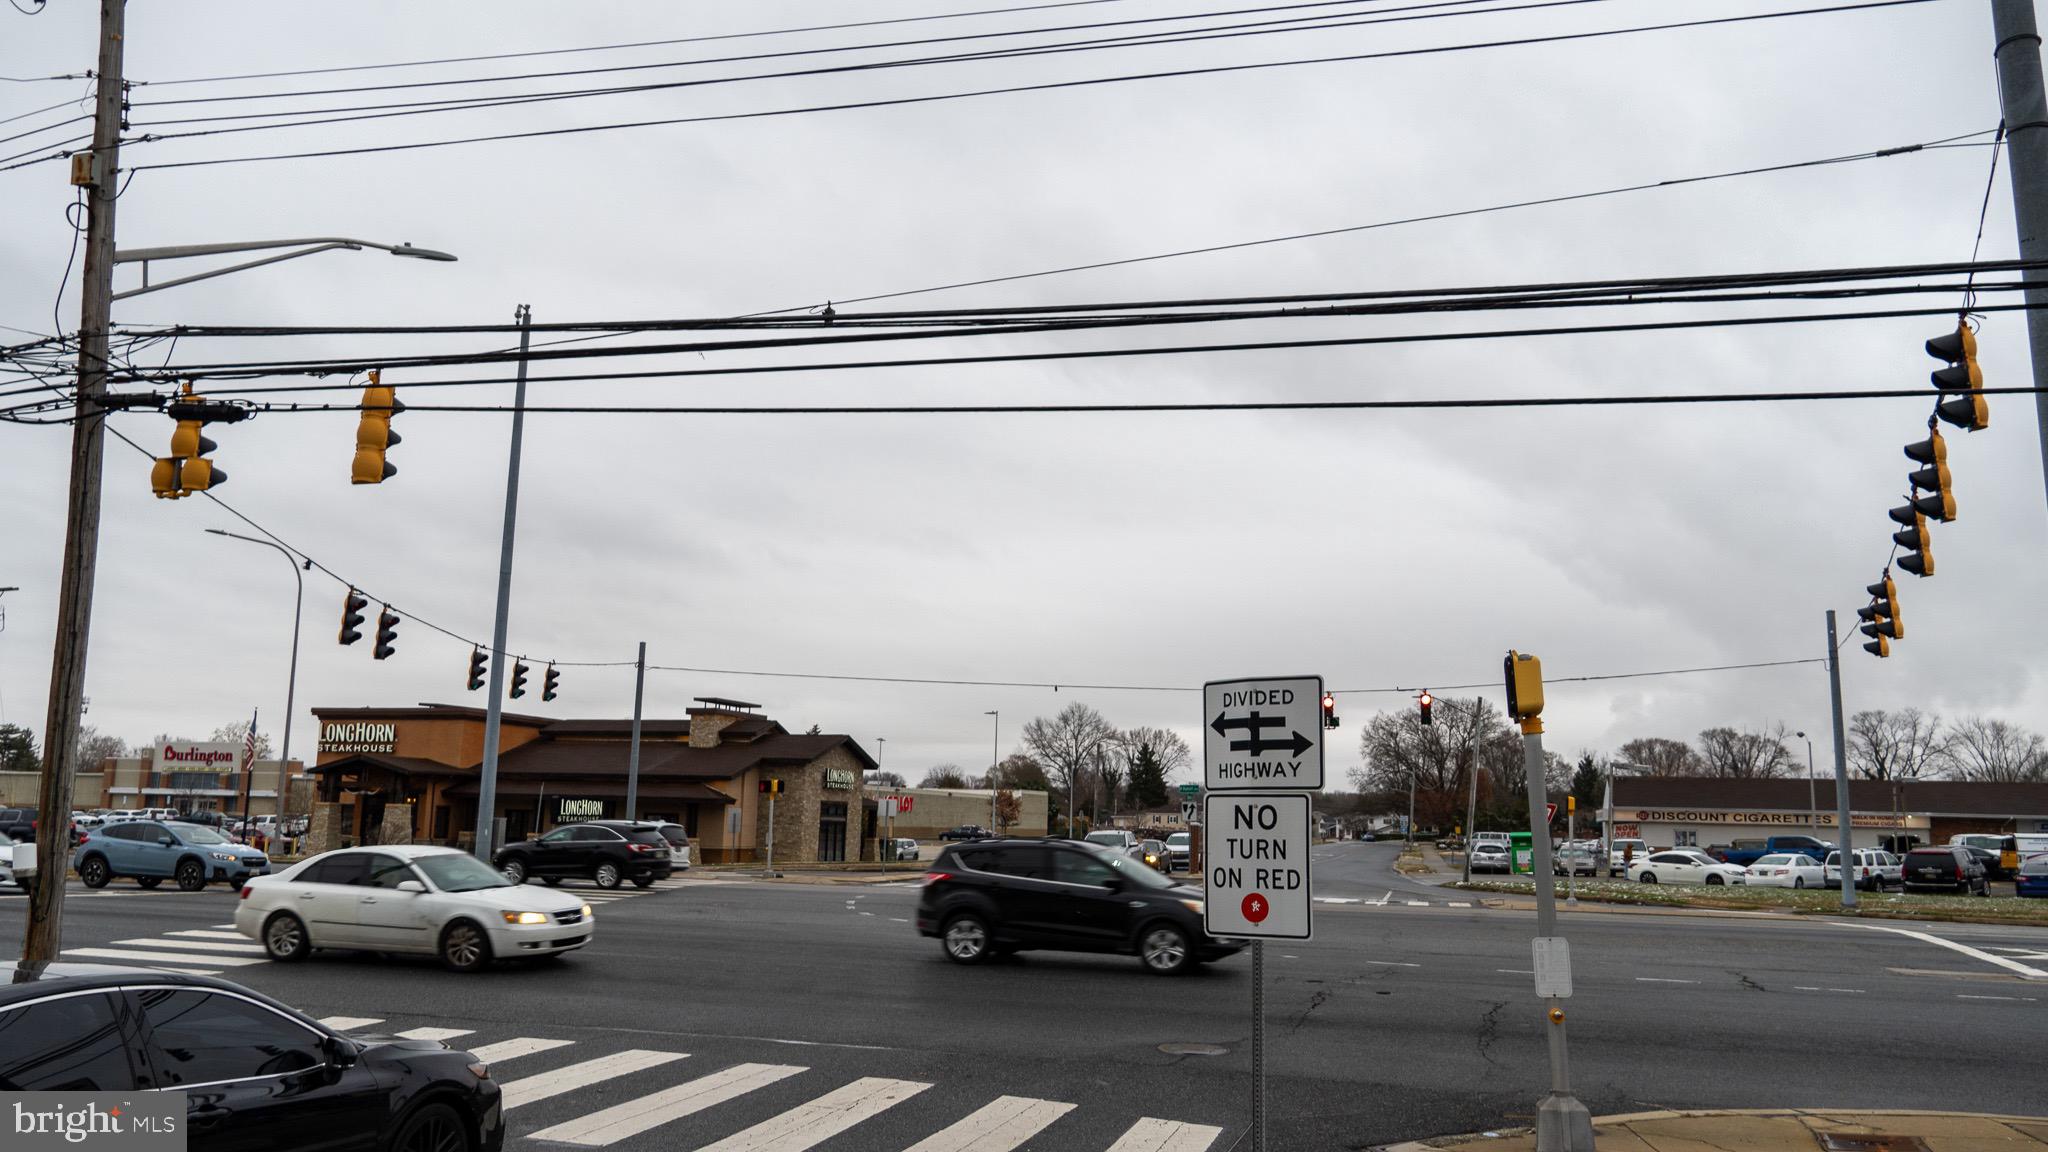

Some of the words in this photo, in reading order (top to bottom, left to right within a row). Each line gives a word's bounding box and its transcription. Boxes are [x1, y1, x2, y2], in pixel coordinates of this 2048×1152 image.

[1223, 689, 1294, 708] DIVIDED
[319, 722, 396, 742] LONGHORN
[164, 745, 233, 767] Burlington
[317, 744, 393, 752] STEAKHOUSE
[1219, 761, 1302, 778] HIGHWAY
[560, 798, 603, 816] LONGHORN
[1234, 804, 1278, 830] NO
[1652, 811, 1728, 822] DISCOUNT
[1733, 813, 1832, 824] CIGARETTES
[1227, 838, 1287, 860] TURN
[1213, 867, 1242, 888] ON
[1256, 868, 1300, 890] RED
